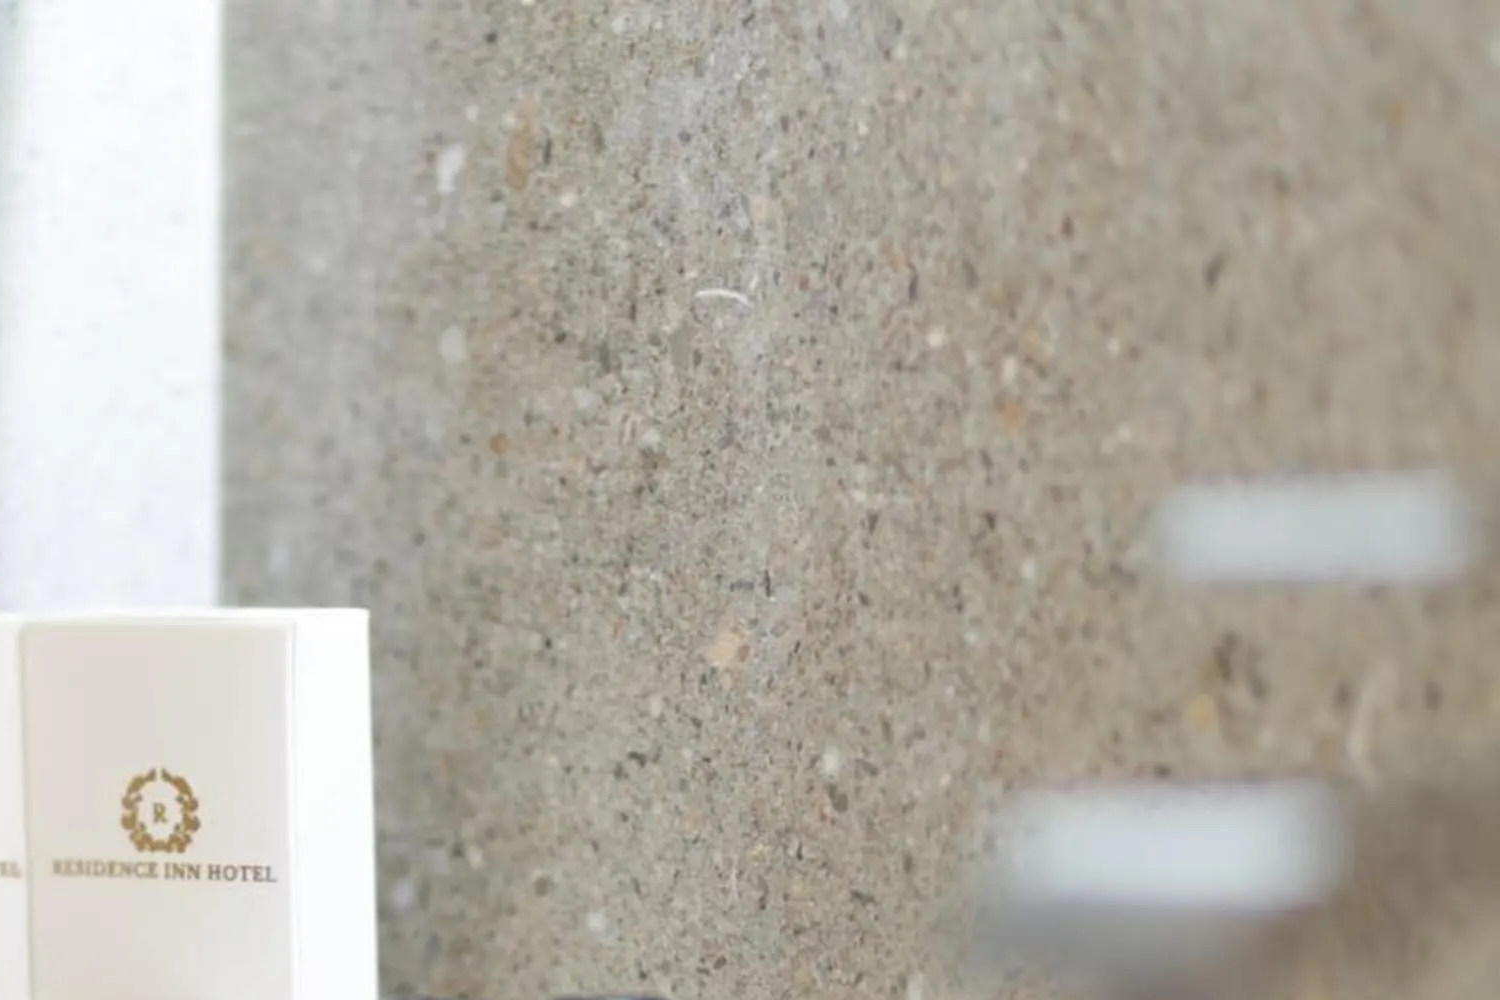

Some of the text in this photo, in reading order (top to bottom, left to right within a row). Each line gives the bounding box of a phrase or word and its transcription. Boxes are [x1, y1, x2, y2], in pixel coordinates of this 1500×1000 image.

[153, 802, 168, 824] R
[52, 858, 277, 883] RESIDENCE INN HOTEL
